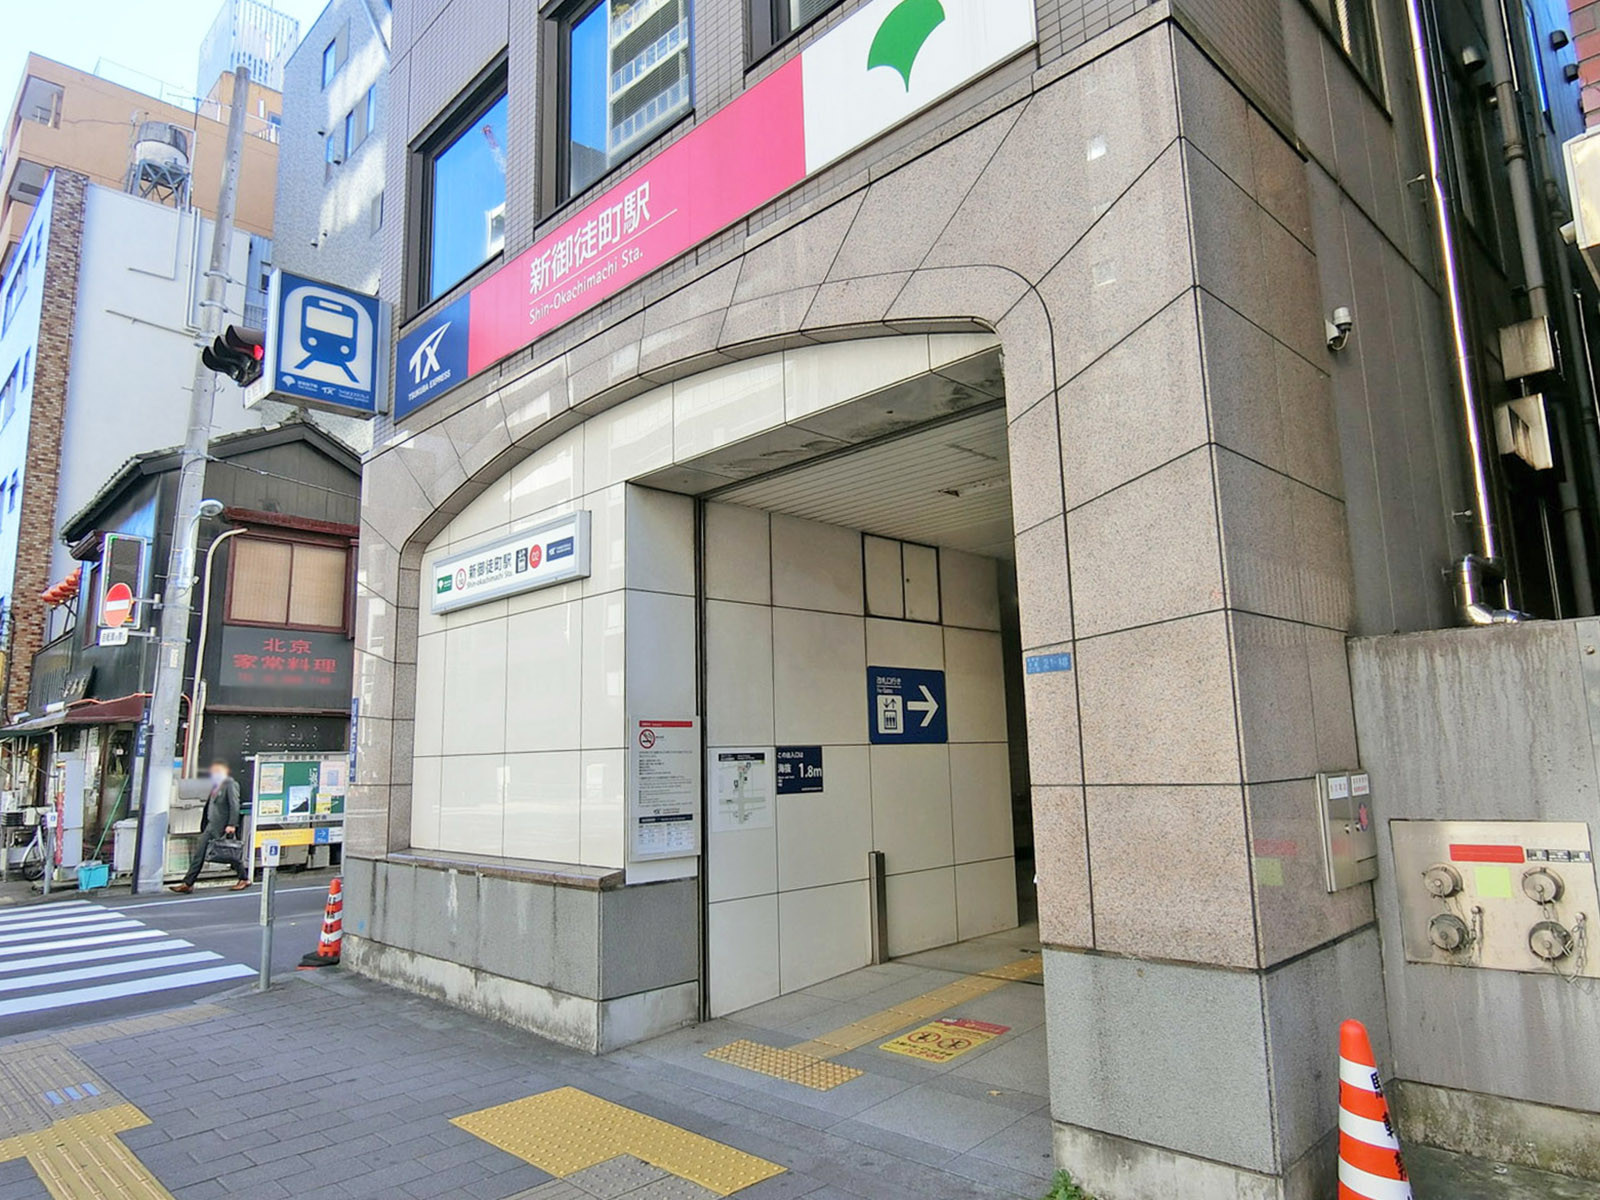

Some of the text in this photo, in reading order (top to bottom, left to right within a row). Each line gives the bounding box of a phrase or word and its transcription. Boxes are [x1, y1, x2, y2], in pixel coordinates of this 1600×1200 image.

[529, 180, 651, 296] 新御徒町駅
[528, 246, 644, 325] Shin-Okachimachi Sta.
[408, 369, 452, 401] TSUKUBA EXPRESS
[468, 552, 512, 579] 新御徒町駅
[263, 638, 313, 654] 北京
[232, 653, 337, 673] 家常料理
[798, 763, 822, 778] 1.8m
